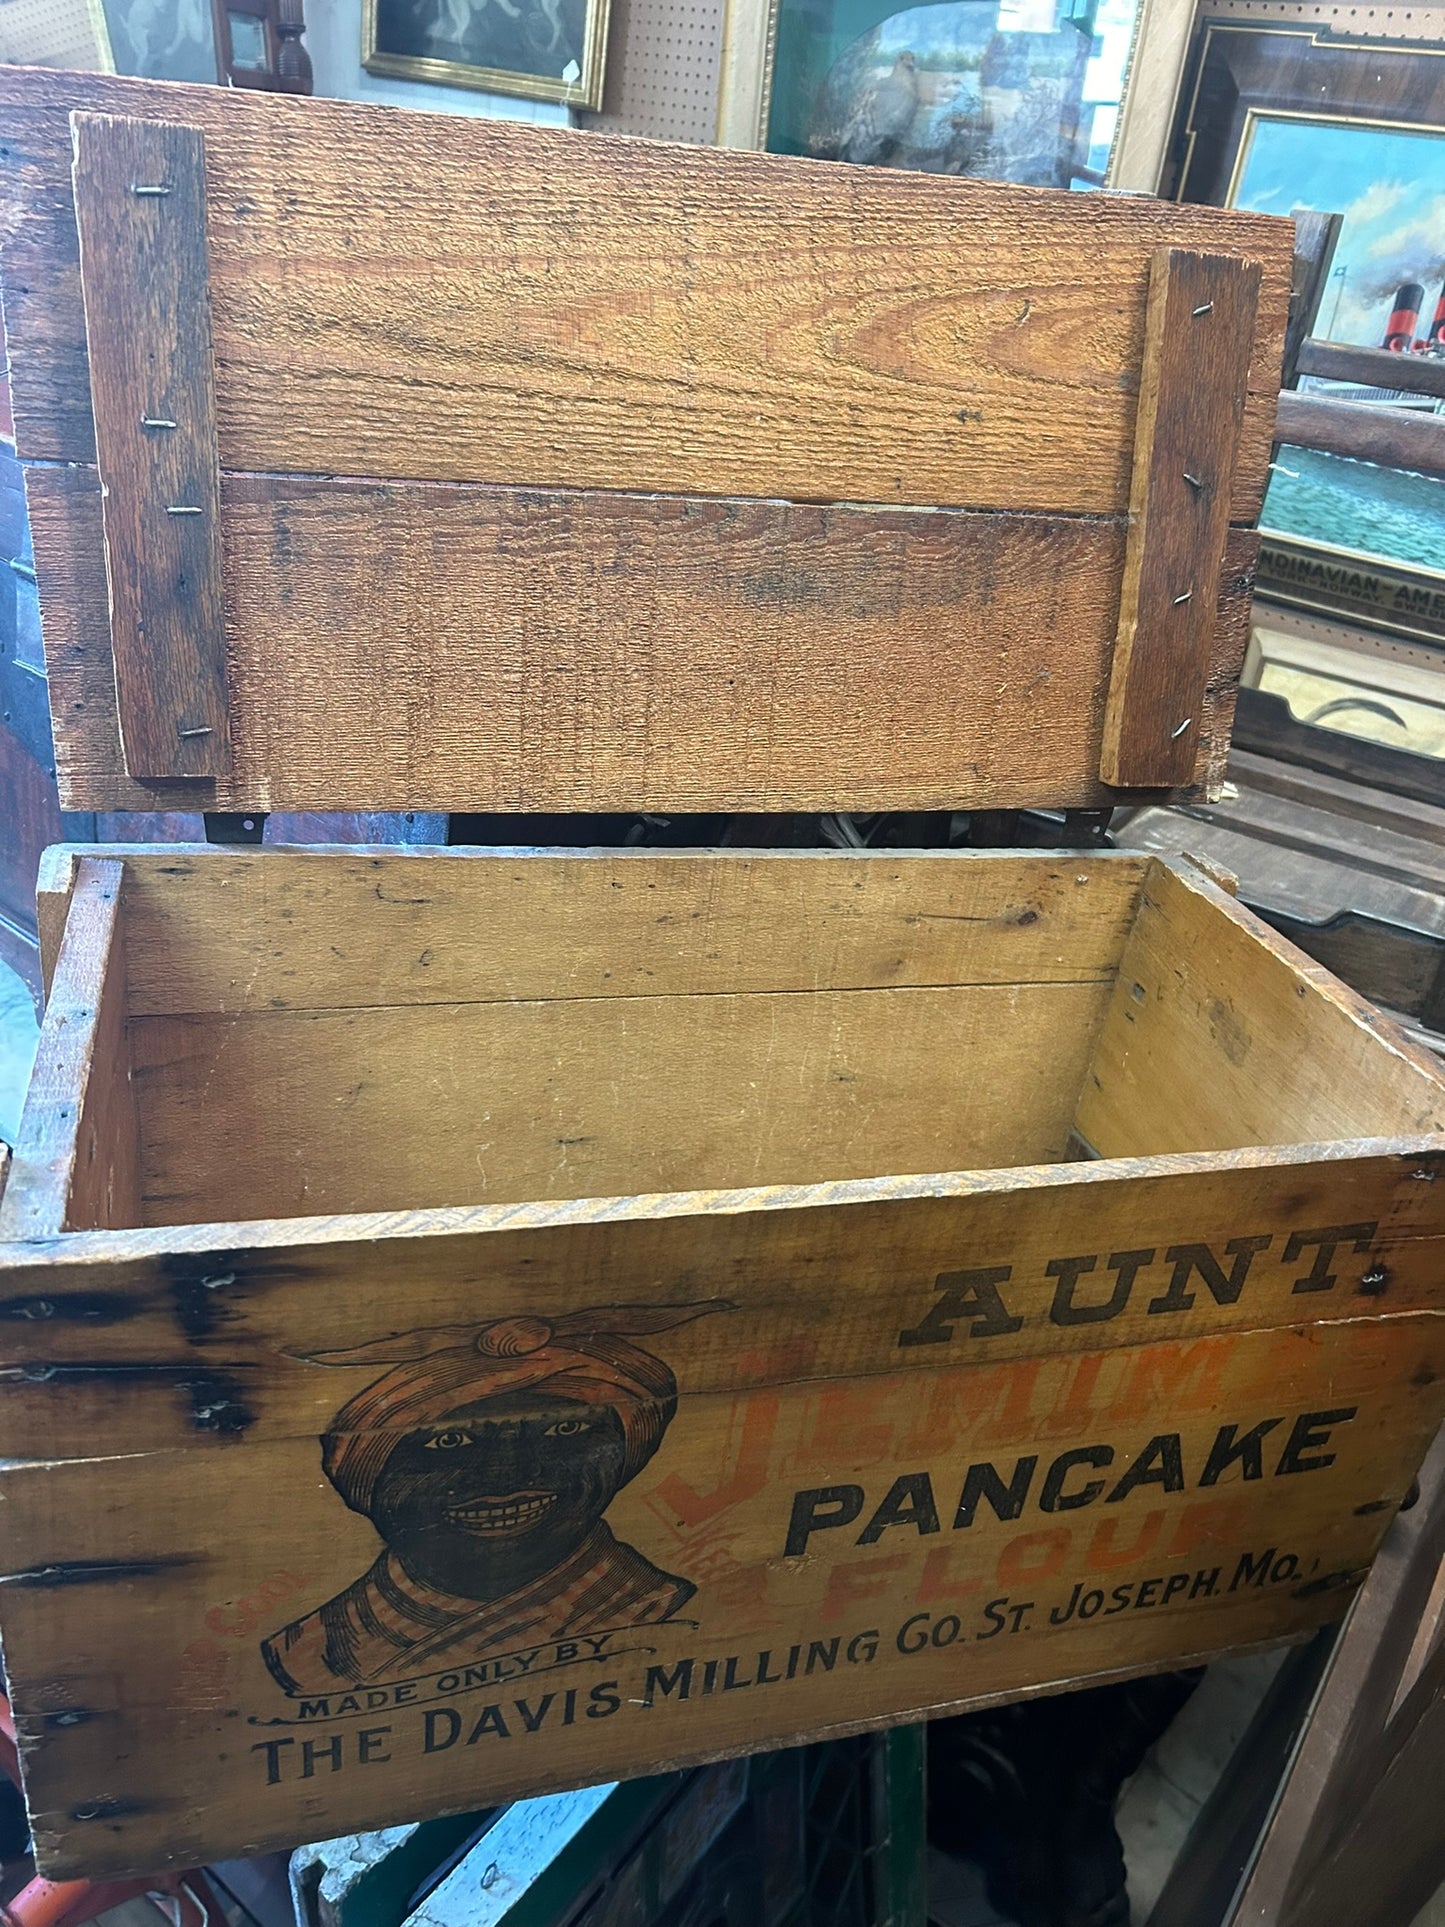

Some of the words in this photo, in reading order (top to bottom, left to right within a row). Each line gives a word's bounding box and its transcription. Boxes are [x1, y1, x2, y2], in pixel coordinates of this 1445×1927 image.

[898, 1221, 1379, 1347] AUNT
[783, 1406, 1358, 1558] PANCAKE
[819, 1500, 1242, 1622] FLOUR
[251, 1725, 394, 1786] THE
[421, 1679, 622, 1754] DAVIS
[642, 1629, 880, 1709] MILLING
[297, 1683, 417, 1721] MADE
[437, 1651, 541, 1692] ONLY
[555, 1633, 615, 1664] BY
